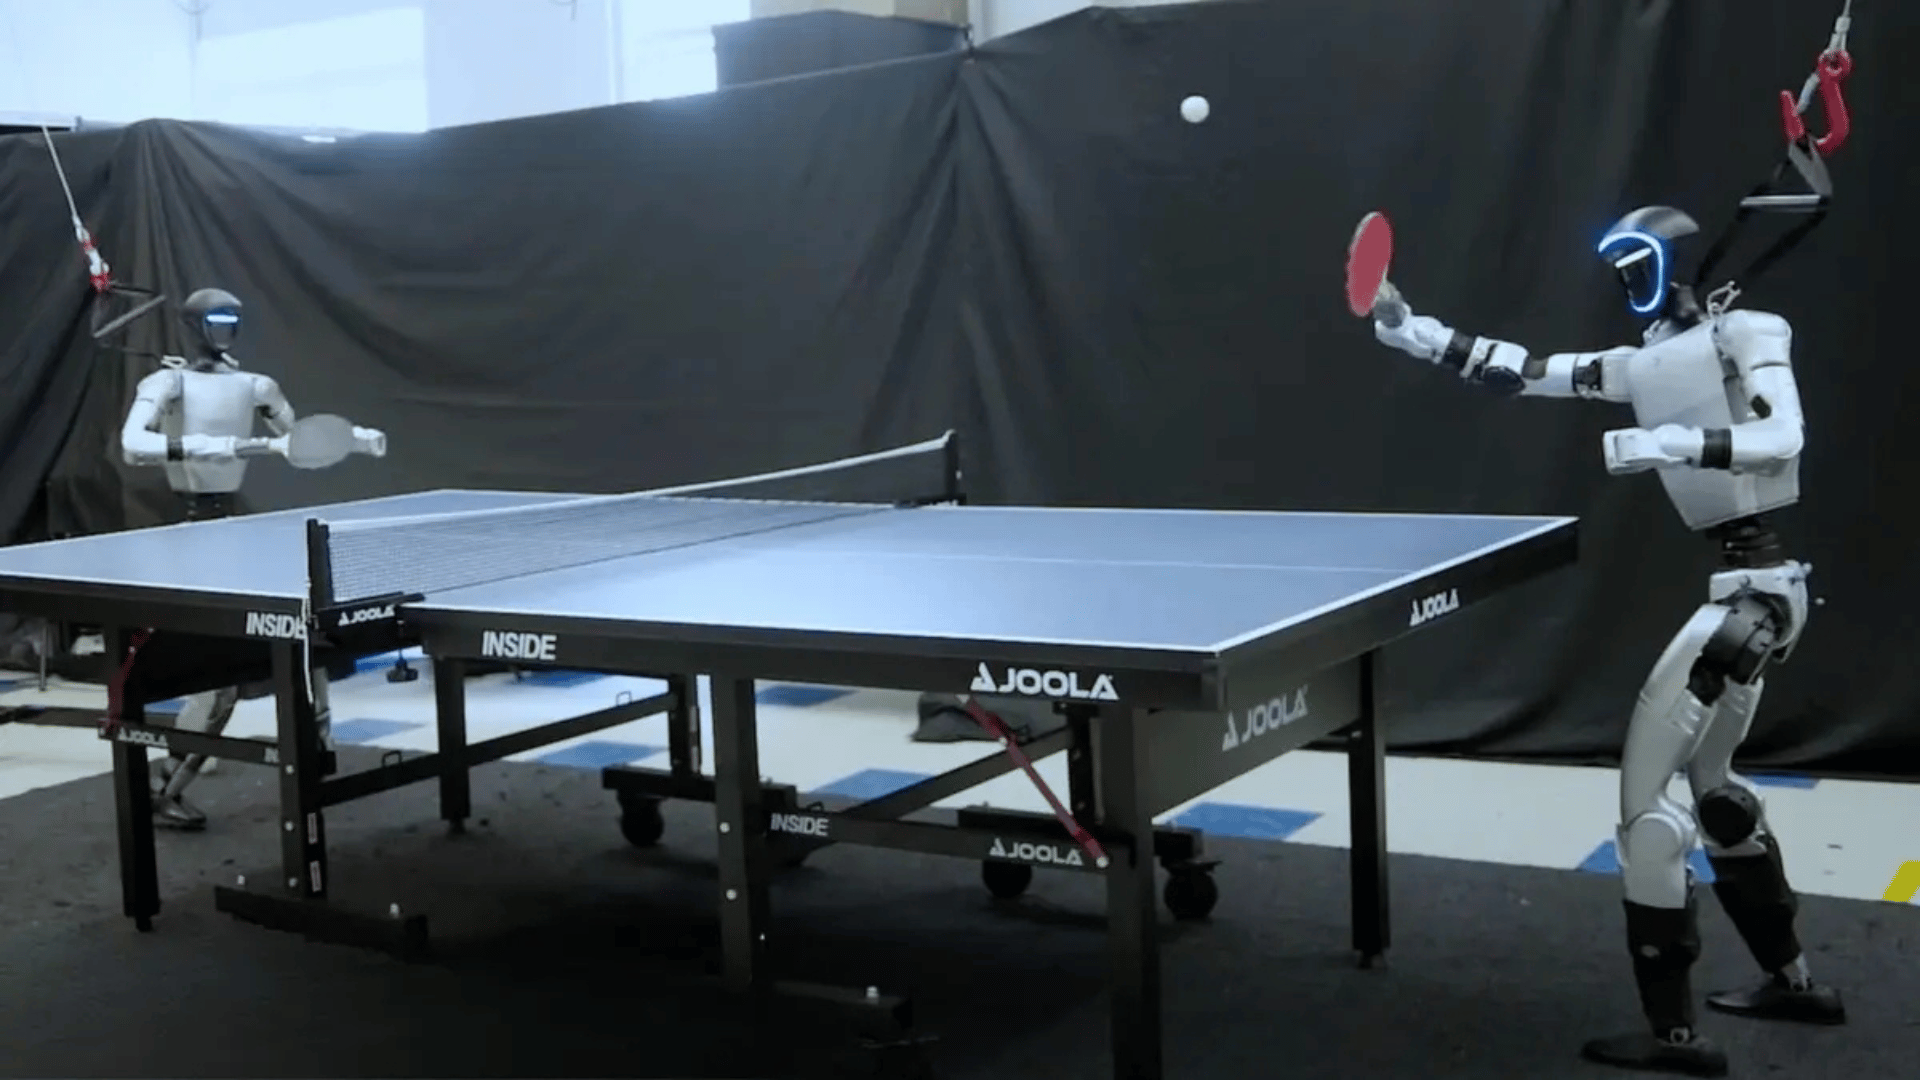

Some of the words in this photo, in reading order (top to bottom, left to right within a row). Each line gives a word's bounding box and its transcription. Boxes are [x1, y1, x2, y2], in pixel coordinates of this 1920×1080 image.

[1418, 588, 1460, 621] JOOLA
[482, 630, 557, 660] INSIDE
[998, 667, 1119, 700] JOOLA
[1241, 687, 1308, 743] JOOLA
[770, 811, 829, 837] INSIDE
[1003, 843, 1083, 867] JOOLA
